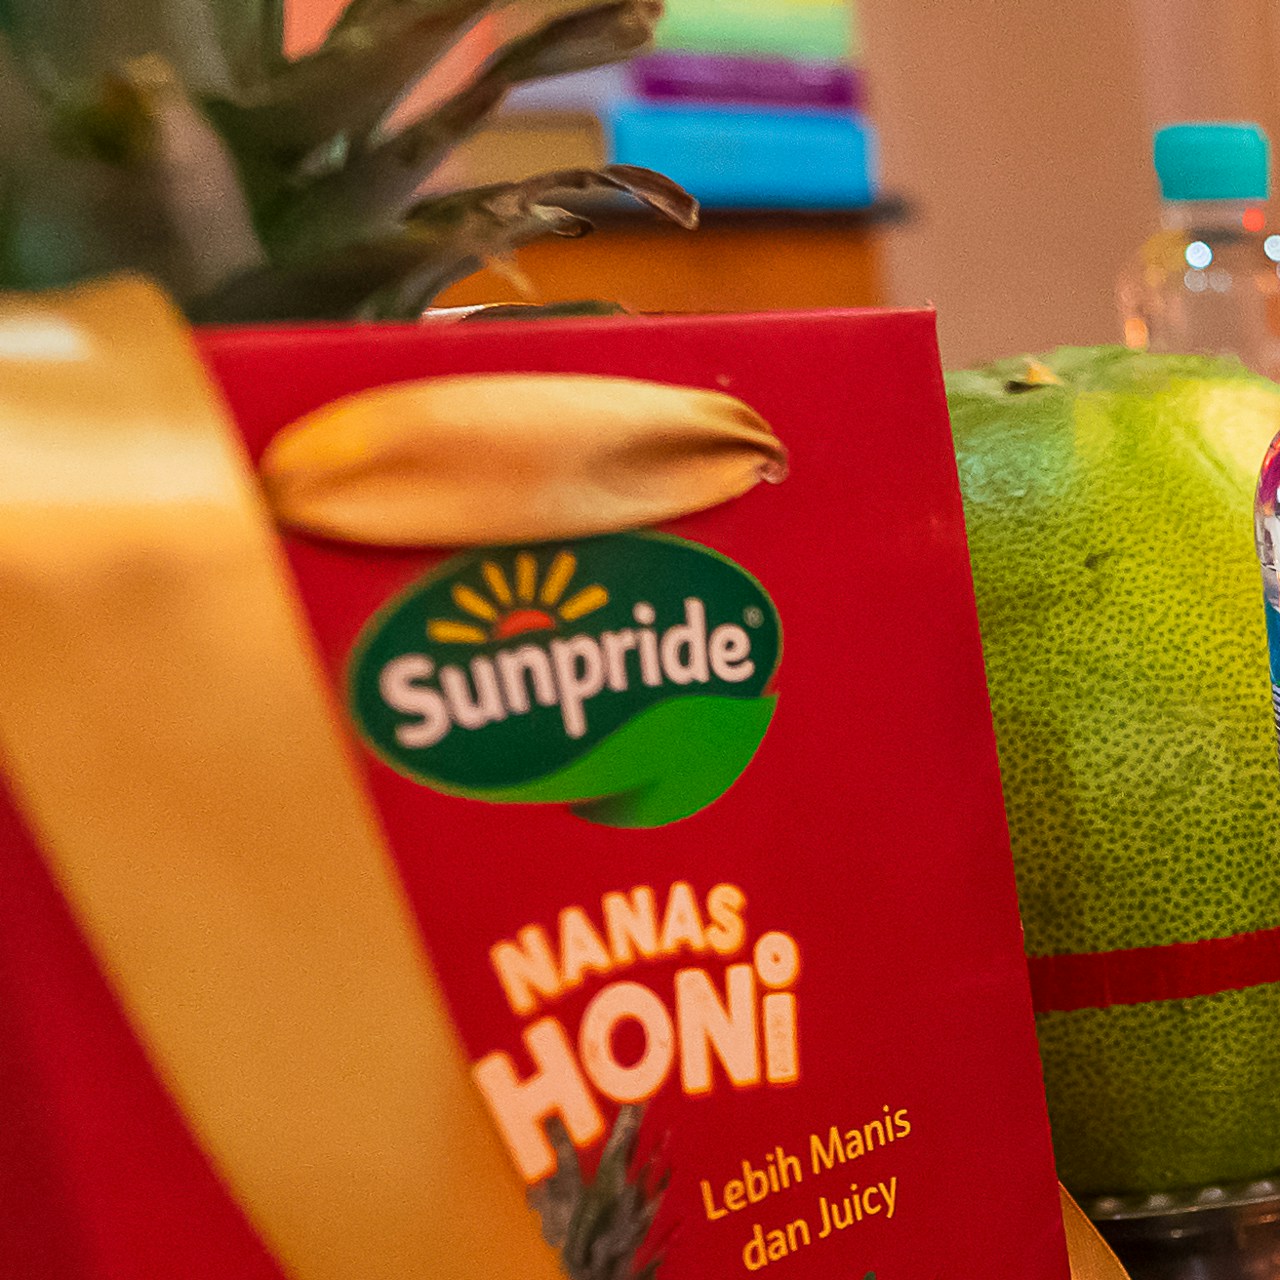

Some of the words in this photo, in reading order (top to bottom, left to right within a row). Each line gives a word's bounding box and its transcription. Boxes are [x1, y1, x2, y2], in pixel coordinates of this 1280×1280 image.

[378, 596, 756, 749] Sunpride
[490, 880, 748, 1016] NANAS
[700, 1146, 802, 1221] Lebih
[810, 1105, 911, 1175] Manis
[743, 1218, 812, 1271] dan
[818, 1177, 897, 1239] Juicy
